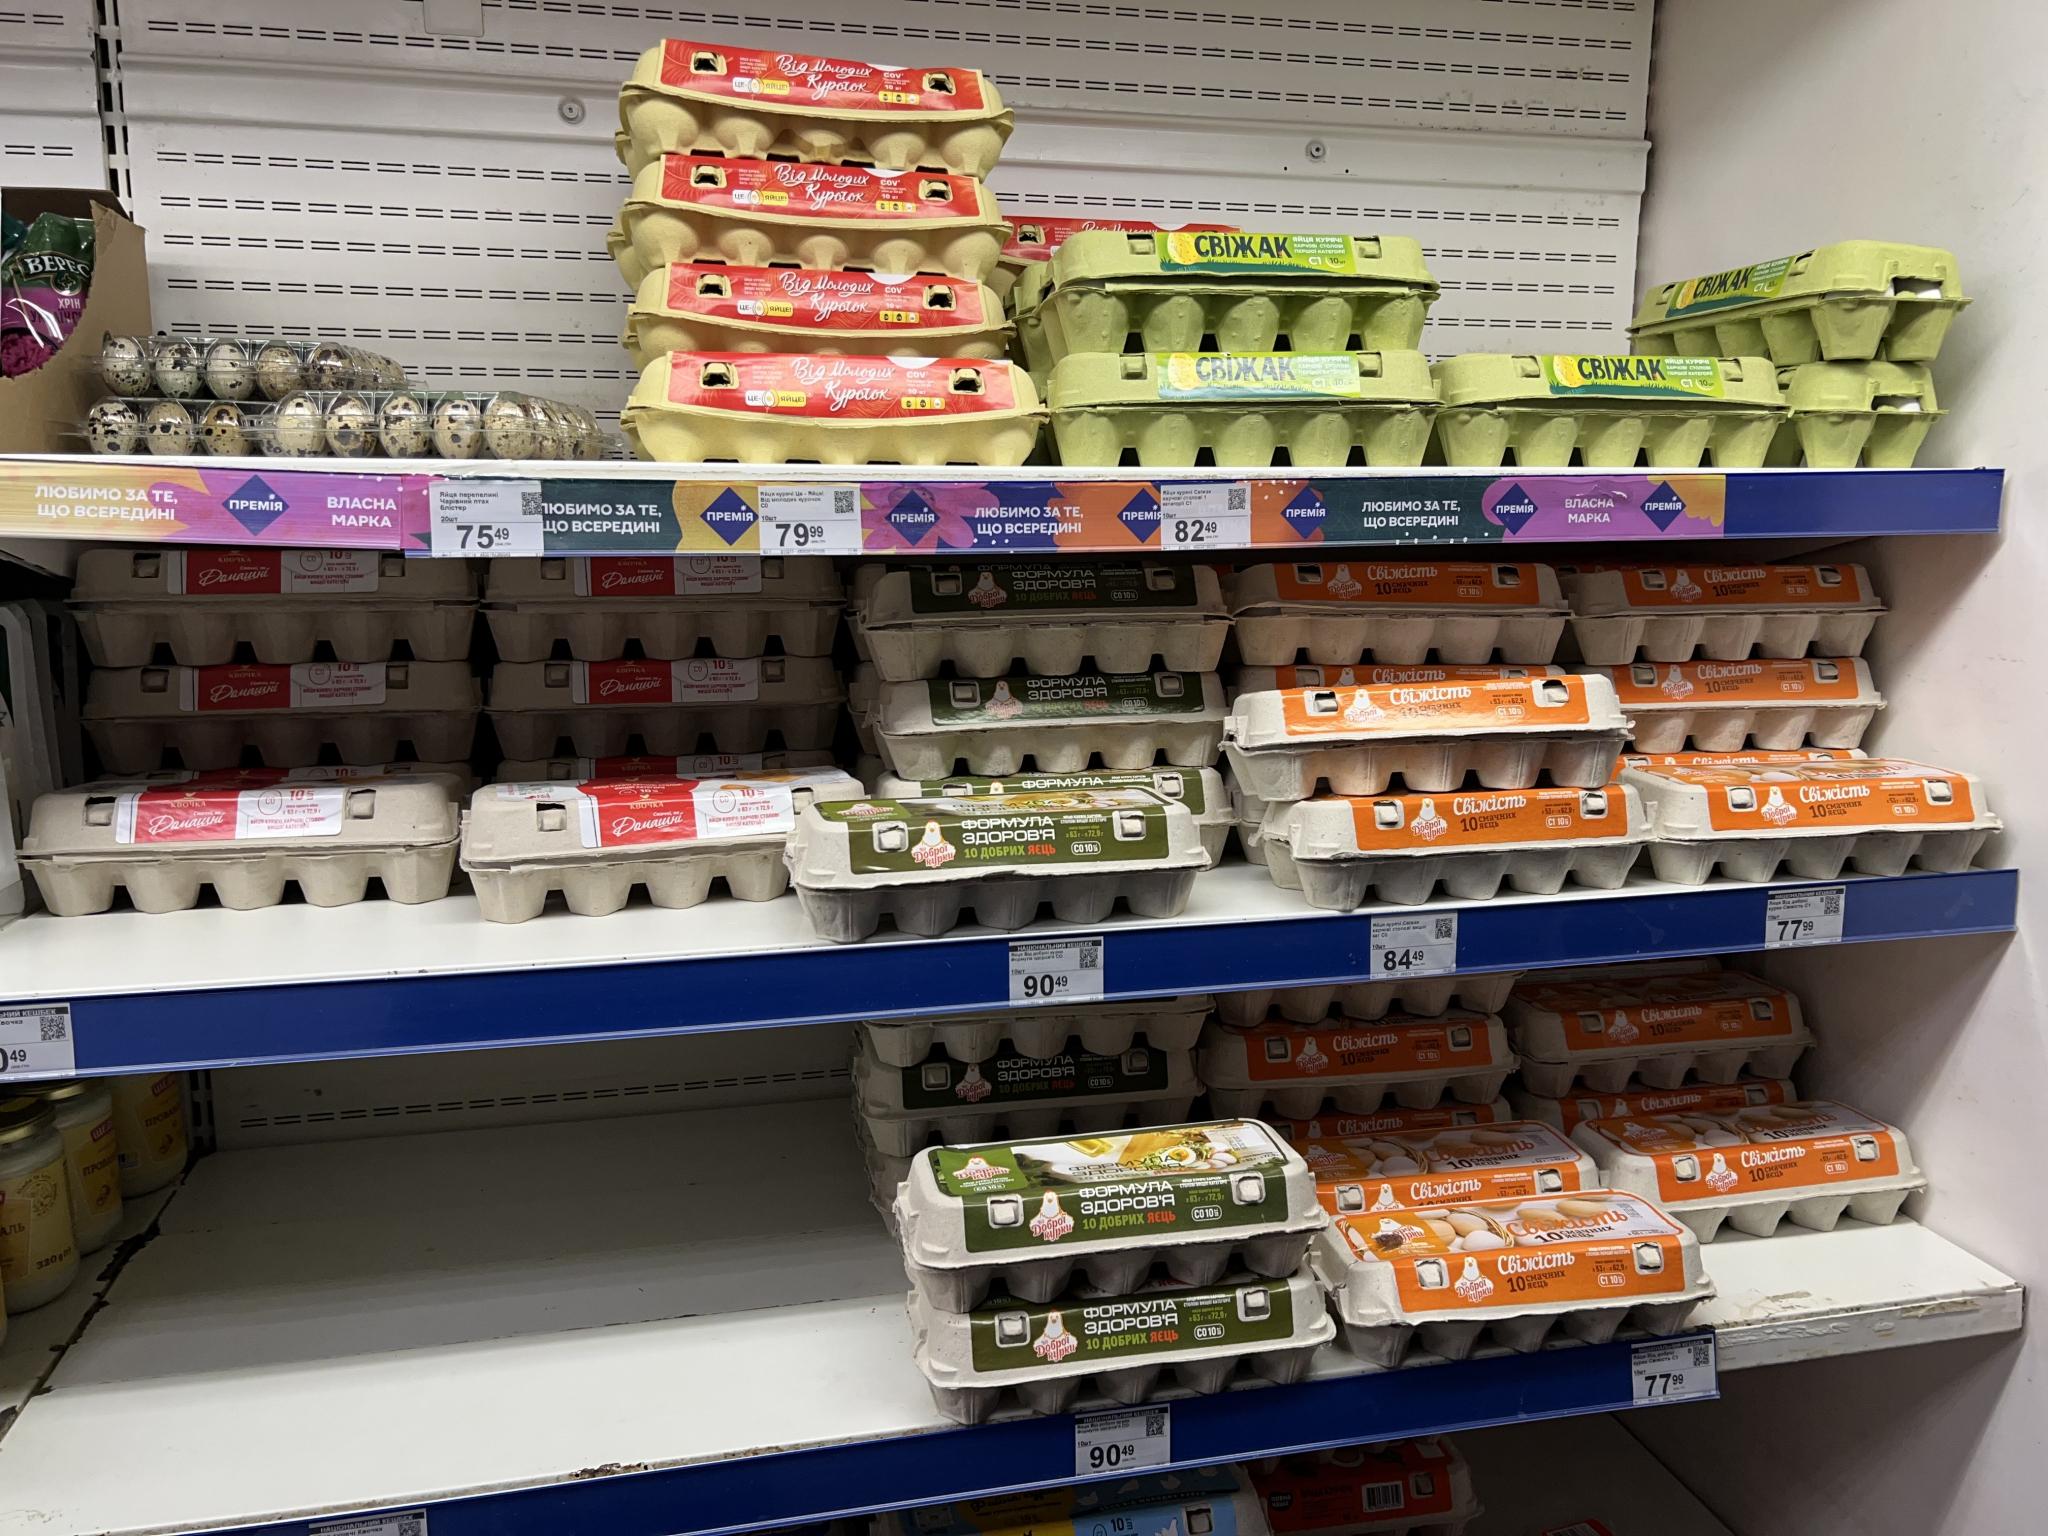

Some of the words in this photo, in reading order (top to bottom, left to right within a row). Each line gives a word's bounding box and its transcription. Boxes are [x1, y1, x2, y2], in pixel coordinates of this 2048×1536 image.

[1194, 234, 1293, 259] СВІЖАК
[24, 255, 91, 278] ВЕРЕС
[1694, 266, 1755, 299] СВІЖАК
[57, 297, 81, 310] ХРІН
[1196, 357, 1296, 381] СВІЖАК
[1577, 358, 1666, 380] СВІЖАК
[34, 485, 121, 501] ЛЮБИМО
[125, 487, 149, 502] ЗА
[152, 489, 178, 505] ТЕ,
[327, 496, 397, 511] ВЛАСНА
[1565, 497, 1614, 509] ВЛАСНА
[1645, 496, 1682, 511] ПРЕМІЯ
[37, 503, 70, 520] ЩО
[74, 505, 175, 521] ВСЕРЕДИНІ
[229, 496, 283, 512] ПРЕМІЯ
[615, 504, 636, 516] ЗА
[638, 505, 663, 518] ТЕ,
[706, 504, 755, 521] ПРЕМІЯ
[1286, 502, 1326, 518] ПРЕМІЯ
[1362, 500, 1421, 512] ЛЮБИМО
[1423, 500, 1440, 511] ЗА
[1442, 500, 1460, 514] ТЕ,
[1496, 498, 1533, 514] ПРЕМІЯ
[331, 514, 392, 528] МАРКА
[891, 506, 935, 522] ПРЕМІЯ
[975, 506, 1040, 519] ЛЮБИМО
[1043, 506, 1061, 518] ЗА
[1063, 506, 1084, 520] ТЕ,
[1364, 516, 1386, 528] ЩО
[1389, 515, 1459, 527] ВСЕРЕДИНІ
[1568, 512, 1610, 524] МАРКА
[571, 521, 661, 534] ВСЕРЕДИНІ
[775, 523, 810, 548] 79
[809, 526, 824, 538] 99
[977, 523, 1003, 536] ЩО
[1005, 523, 1082, 535] ВСЕРЕДИНІ
[1175, 520, 1204, 542] 82
[1204, 521, 1217, 533] 49
[456, 525, 495, 549] 75
[494, 527, 509, 541] 49
[1012, 569, 1094, 578] ФОРМУЛА
[1367, 564, 1438, 581] Свіжість
[1704, 568, 1766, 583] Свіжість
[1013, 578, 1096, 591] ЗДОРОВ'Я
[1373, 669, 1446, 684] Свіжість
[1697, 664, 1762, 681] Свіжість
[1027, 676, 1106, 688] ФОРМУЛА
[1706, 681, 1721, 693] 10
[1028, 686, 1108, 700] ЗДОРОВ'Я
[1390, 687, 1472, 707] Свіжість
[1022, 777, 1104, 790] ФОРМУЛА
[1799, 784, 1870, 803] Свіжість
[1453, 795, 1527, 816] Свіжість
[1808, 805, 1826, 819] 10
[962, 815, 1054, 829] ФОРМУЛА
[1460, 818, 1478, 832] 10
[1478, 812, 1517, 823] смачних
[1479, 821, 1499, 831] яєць
[962, 829, 1056, 846] ЗДОРОВ'Я
[964, 847, 977, 859] 10
[980, 845, 1026, 860] ДОБРИХ
[1027, 843, 1057, 858] ЯЄЦЬ
[1085, 843, 1093, 852] 10
[1777, 919, 1803, 941] 77
[1802, 921, 1814, 931] 99
[1384, 949, 1412, 971] 84
[1412, 950, 1424, 961] 49
[1024, 974, 1054, 997] 90
[1055, 976, 1068, 987] 49
[22, 1008, 56, 1017] КЕШБЕК
[1333, 1033, 1398, 1052] Свіжість
[10, 1049, 27, 1062] 49
[997, 1056, 1074, 1069] ФОРМУЛА
[998, 1066, 1075, 1081] ЗДОРОВ'Я
[1641, 1094, 1702, 1111] Свіжість
[1337, 1117, 1404, 1135] Свіжість
[1740, 1146, 1807, 1168] Свіжість
[1748, 1168, 1765, 1183] 10
[1079, 1180, 1174, 1197] ФОРМУЛА
[1411, 1179, 1482, 1199] Свіжість
[1080, 1193, 1176, 1215] ЗДОРОВ'Я
[1083, 1218, 1097, 1230] 10
[1099, 1214, 1146, 1231] ДОБРИХ
[1147, 1211, 1177, 1227] ЯЄЦЬ
[1193, 1210, 1204, 1218] С0
[1205, 1209, 1214, 1218] 10
[1031, 1215, 1068, 1237] Доброї
[1506, 1209, 1627, 1239] Свіжість
[1535, 1232, 1562, 1243] 10
[1497, 1251, 1575, 1274] Свіжість
[1456, 1279, 1487, 1298] Доброї
[1507, 1276, 1526, 1292] 10
[1525, 1271, 1565, 1282] смачних
[1527, 1279, 1549, 1290] яєць
[1083, 1299, 1177, 1319] ФОРМУЛА
[1084, 1314, 1179, 1336] ЗДОРОВ'Я
[1196, 1329, 1207, 1338] С0
[1207, 1327, 1217, 1336] 10
[1035, 1335, 1072, 1357] Доброї
[1085, 1338, 1100, 1351] 10
[1102, 1334, 1148, 1351] ДОБРИХ
[1149, 1330, 1179, 1347] ЯЄЦЬ
[1645, 1373, 1671, 1396] 77
[1672, 1374, 1684, 1385] 99
[1090, 1444, 1121, 1469] 90
[1121, 1445, 1134, 1456] 49
